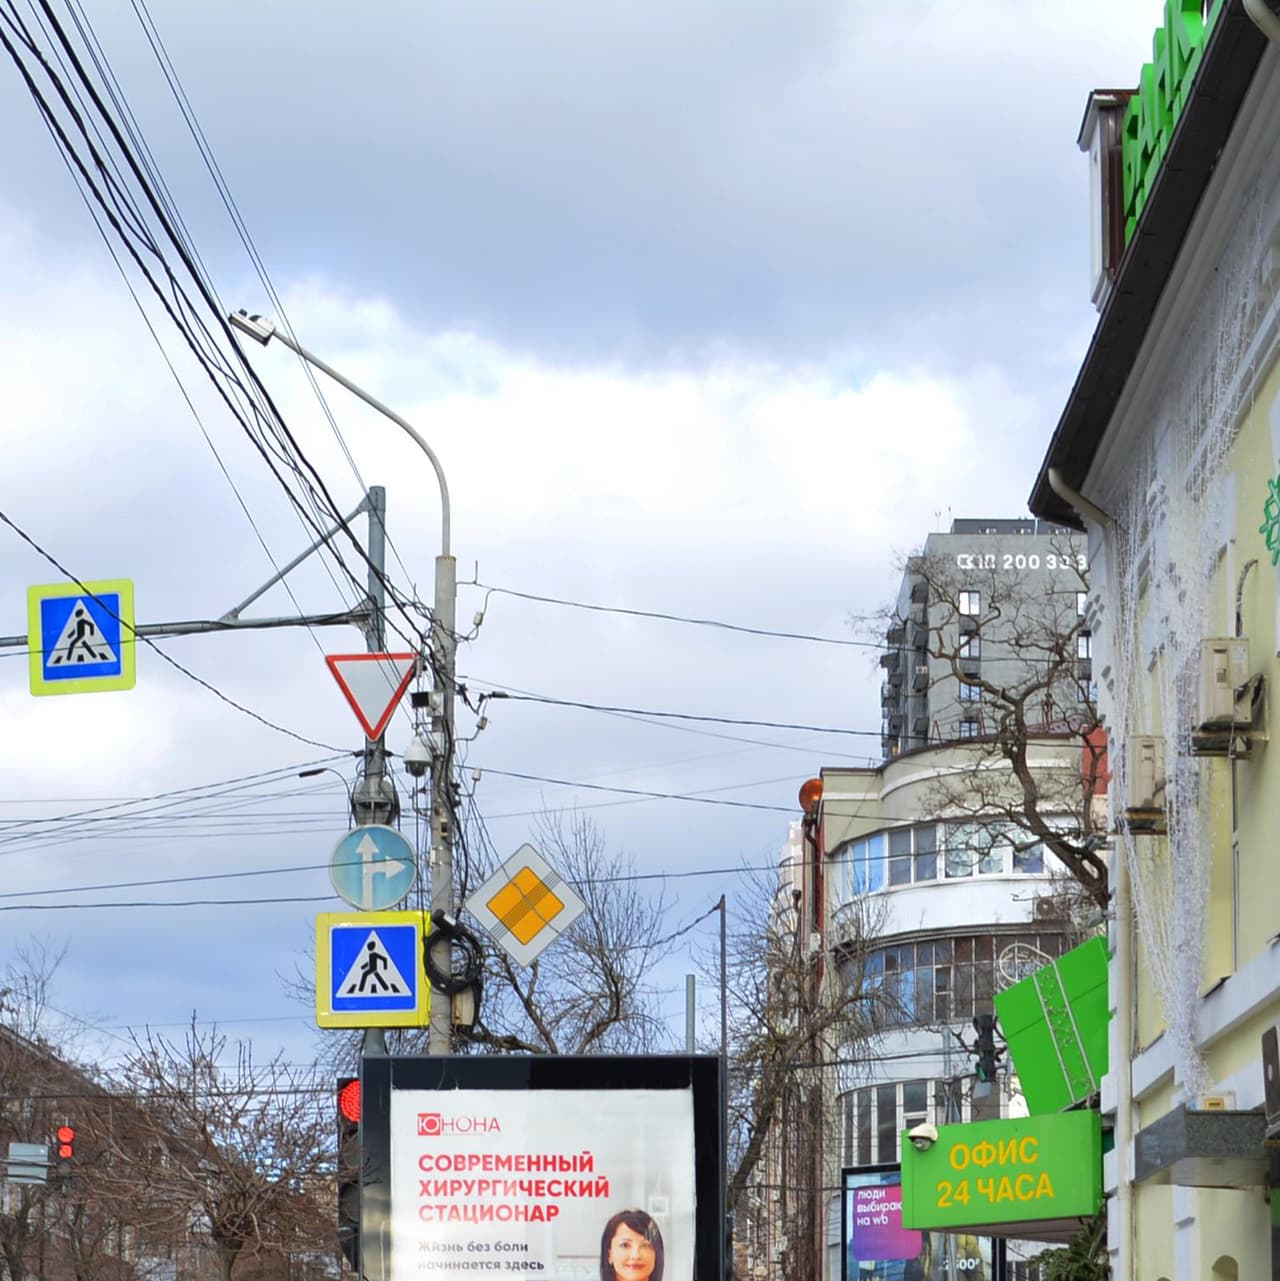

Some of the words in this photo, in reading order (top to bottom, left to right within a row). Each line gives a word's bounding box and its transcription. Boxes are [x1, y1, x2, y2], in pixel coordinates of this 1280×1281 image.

[1003, 554, 1040, 570] 200
[418, 1113, 501, 1136] ЮНОНА
[418, 1151, 594, 1172] СОВРЕМЕННЫЙ
[949, 1135, 1039, 1171] ОФИС
[418, 1176, 609, 1198] ХИРУРГИЧЕСКИЙ
[857, 1189, 885, 1200] люди
[936, 1179, 970, 1208] 24
[977, 1171, 1055, 1203] ЧАСА
[418, 1204, 559, 1224] СТАЦИОНАР
[857, 1200, 902, 1213] выбираю
[857, 1217, 870, 1226] на
[872, 1213, 888, 1225] wb
[418, 1241, 463, 1252] Жизнь
[467, 1240, 490, 1252] без
[494, 1240, 528, 1252] боли
[418, 1260, 501, 1270] начинается
[504, 1260, 544, 1272] здесь
